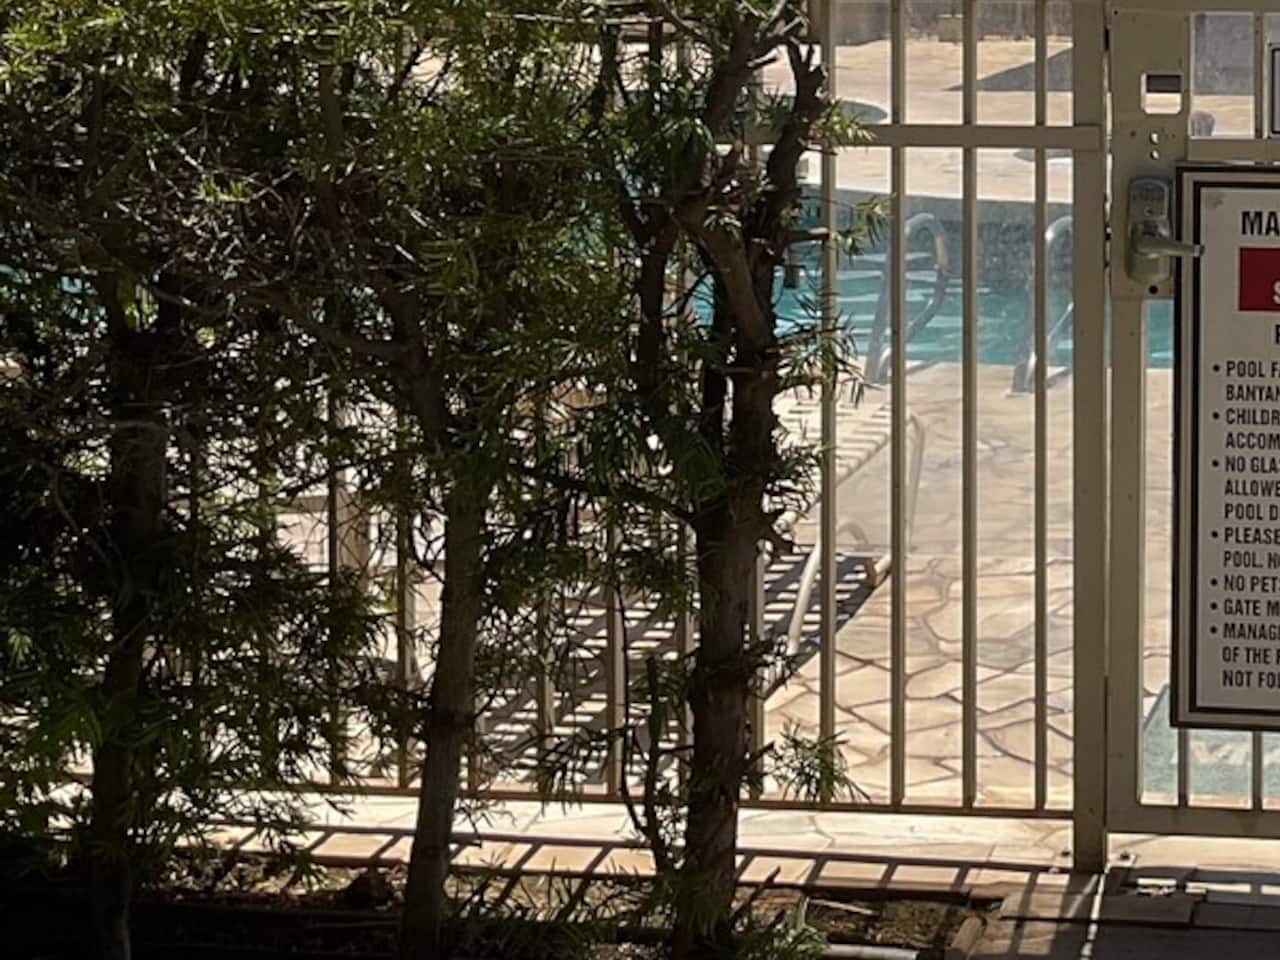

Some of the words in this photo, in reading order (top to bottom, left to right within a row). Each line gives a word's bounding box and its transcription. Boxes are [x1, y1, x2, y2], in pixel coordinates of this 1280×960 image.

[1227, 361, 1265, 378] POOL
[1225, 456, 1246, 473] NO
[1224, 503, 1264, 520] POOL
[1224, 574, 1246, 591] NO
[1224, 598, 1261, 616] GATE
[1222, 646, 1240, 662] OF
[1245, 647, 1272, 665] THE
[1223, 670, 1254, 687] NOT
